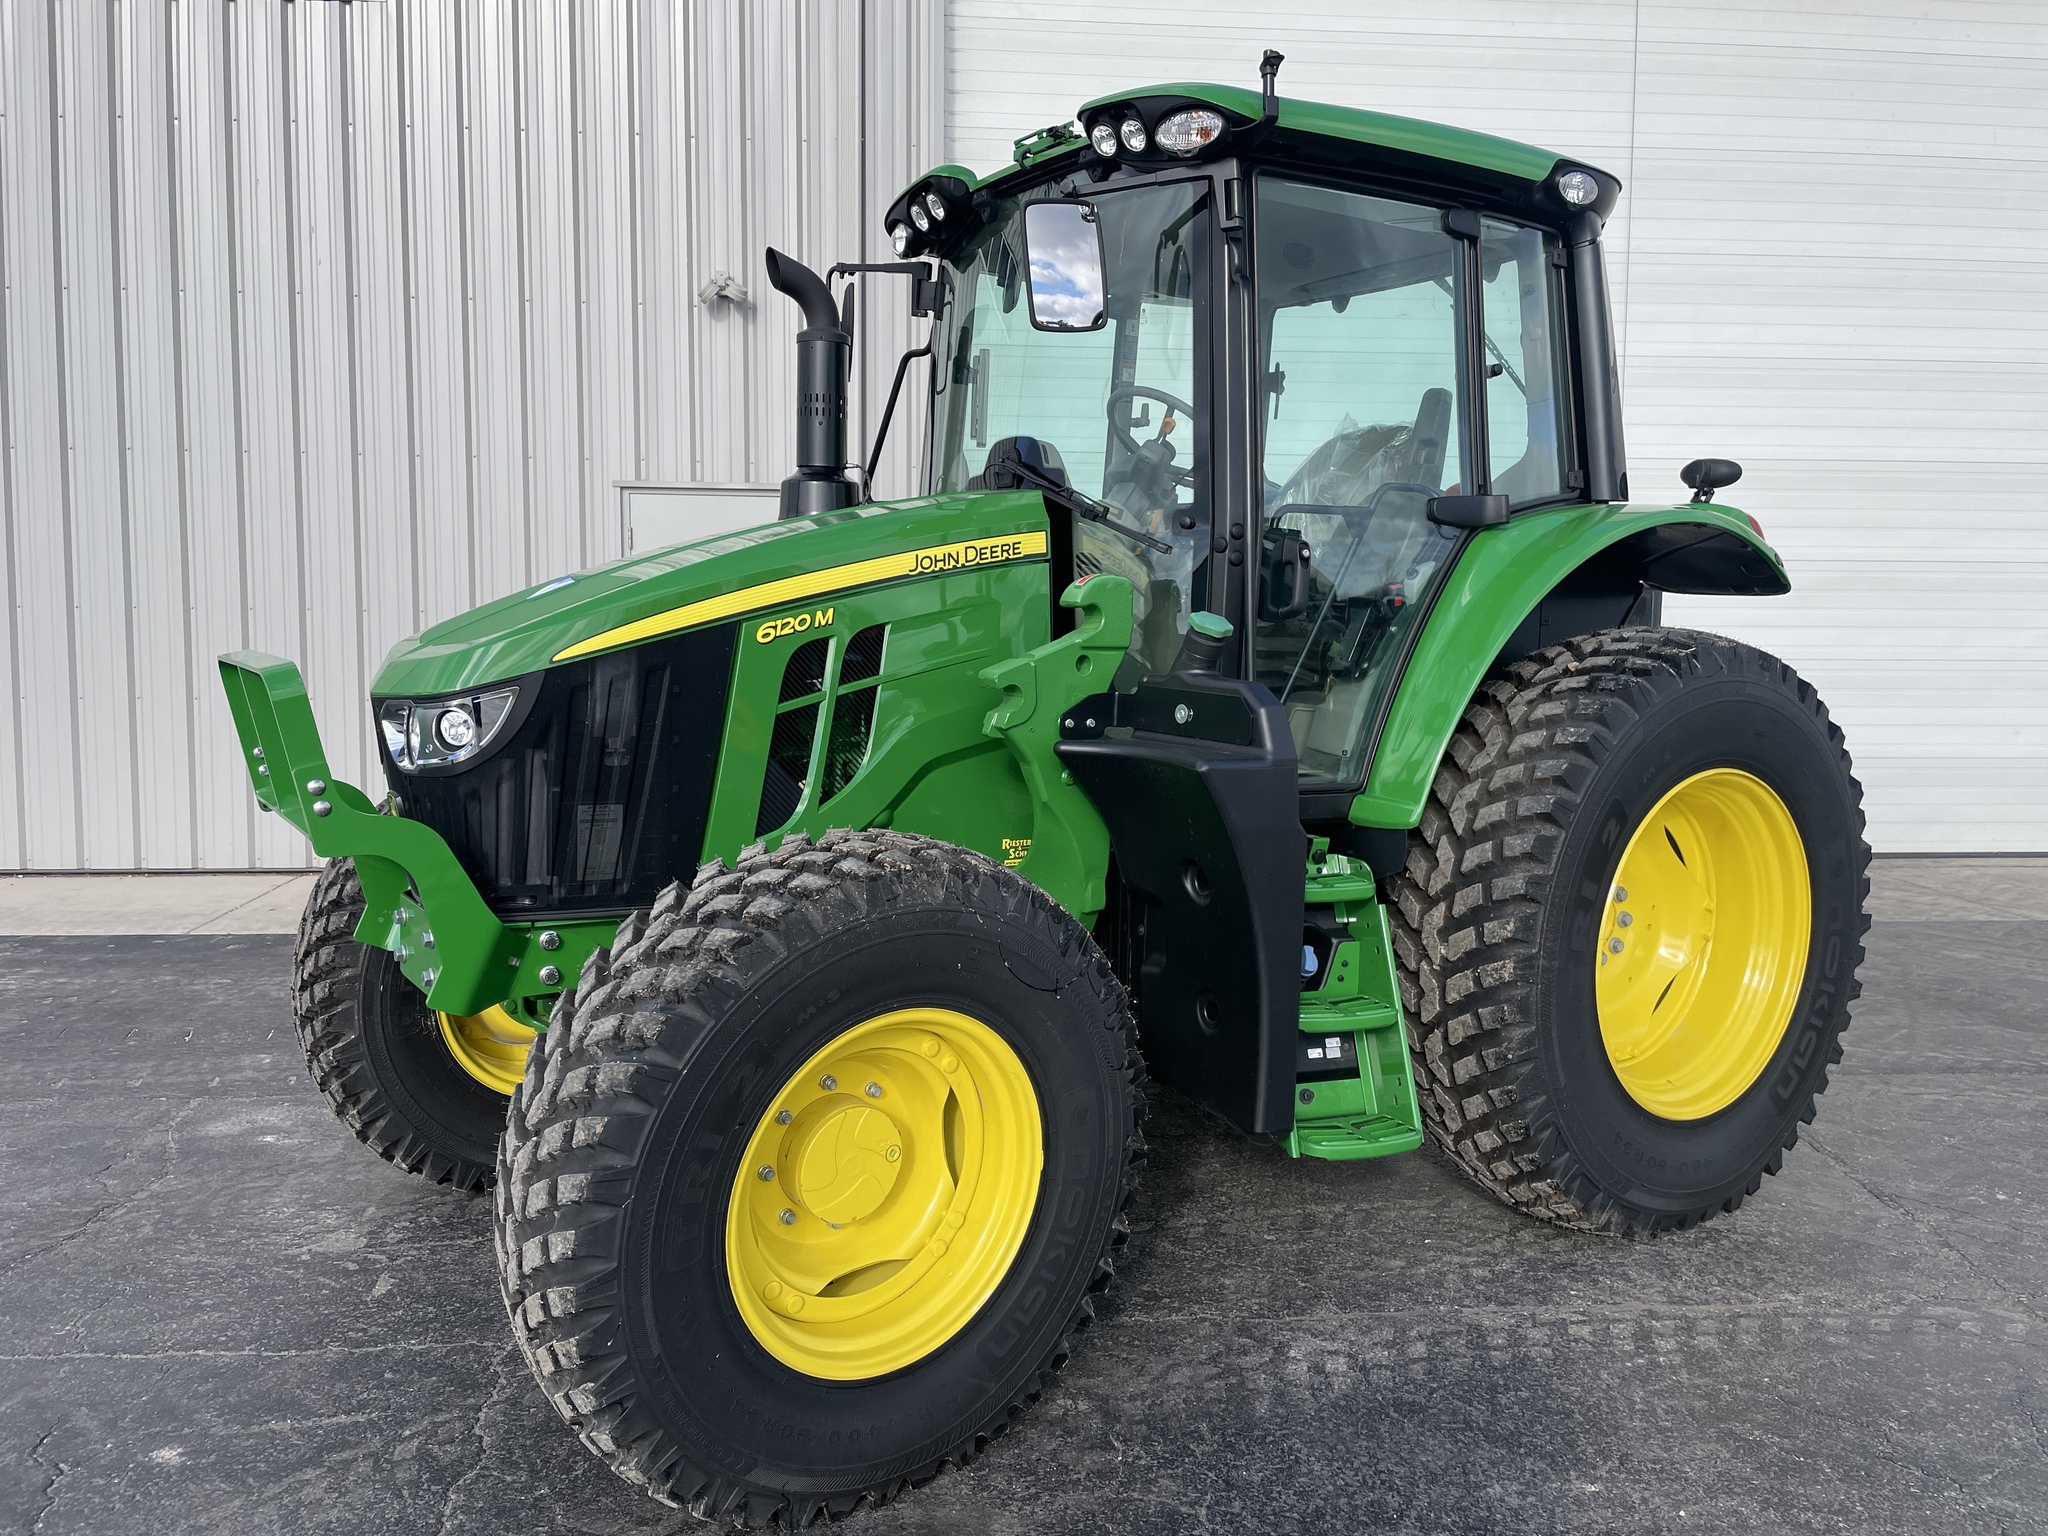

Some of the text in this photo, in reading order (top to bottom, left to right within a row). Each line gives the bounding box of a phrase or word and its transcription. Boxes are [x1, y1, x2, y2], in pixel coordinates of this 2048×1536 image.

[909, 541, 1022, 573] JOHN DEERE
[756, 607, 835, 645] 6120 M
[1002, 838, 1031, 850] RIESTER
[671, 1056, 764, 1252] TRI 2
